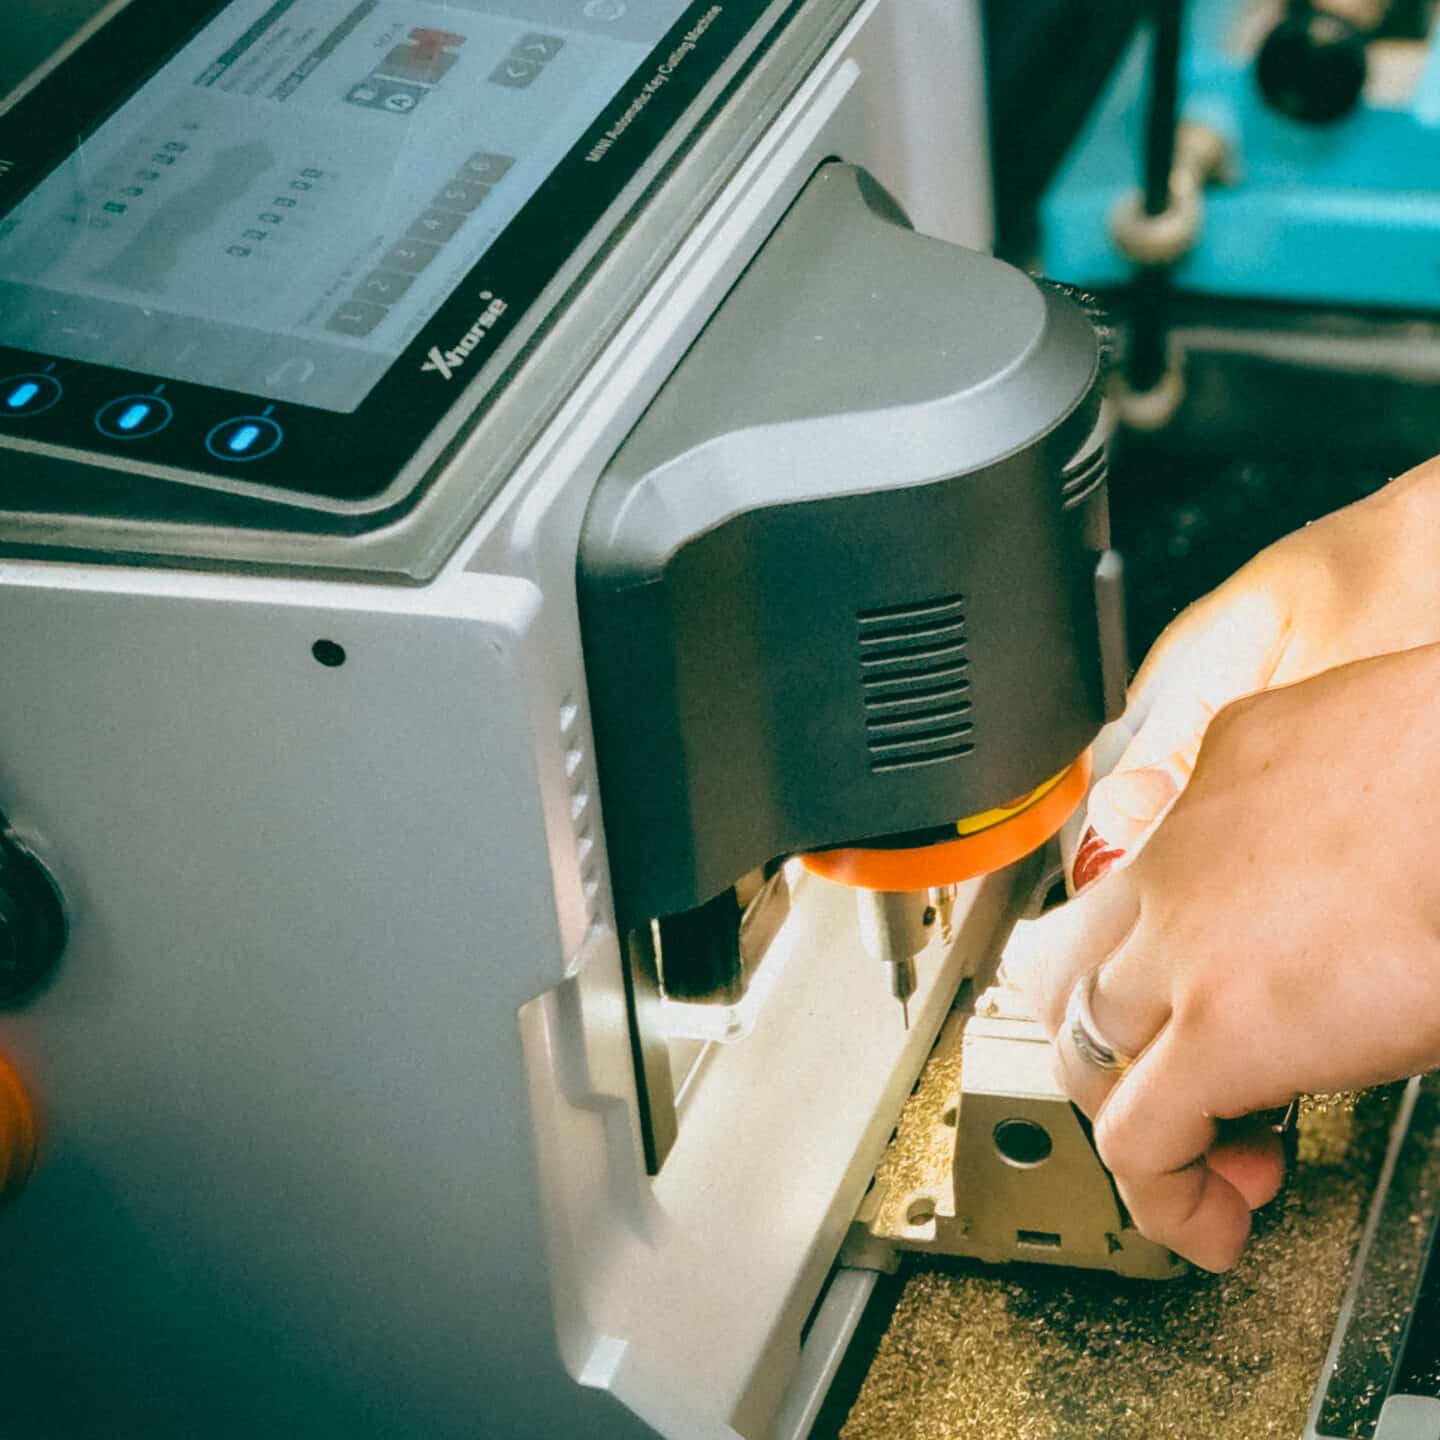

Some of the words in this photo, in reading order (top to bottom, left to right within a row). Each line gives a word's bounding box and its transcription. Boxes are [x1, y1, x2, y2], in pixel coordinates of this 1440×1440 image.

[585, 138, 614, 162] MINI
[605, 93, 652, 140] Automatic
[642, 74, 669, 94] Key
[657, 41, 696, 74] Cutting
[421, 298, 508, 380] Xhorse
